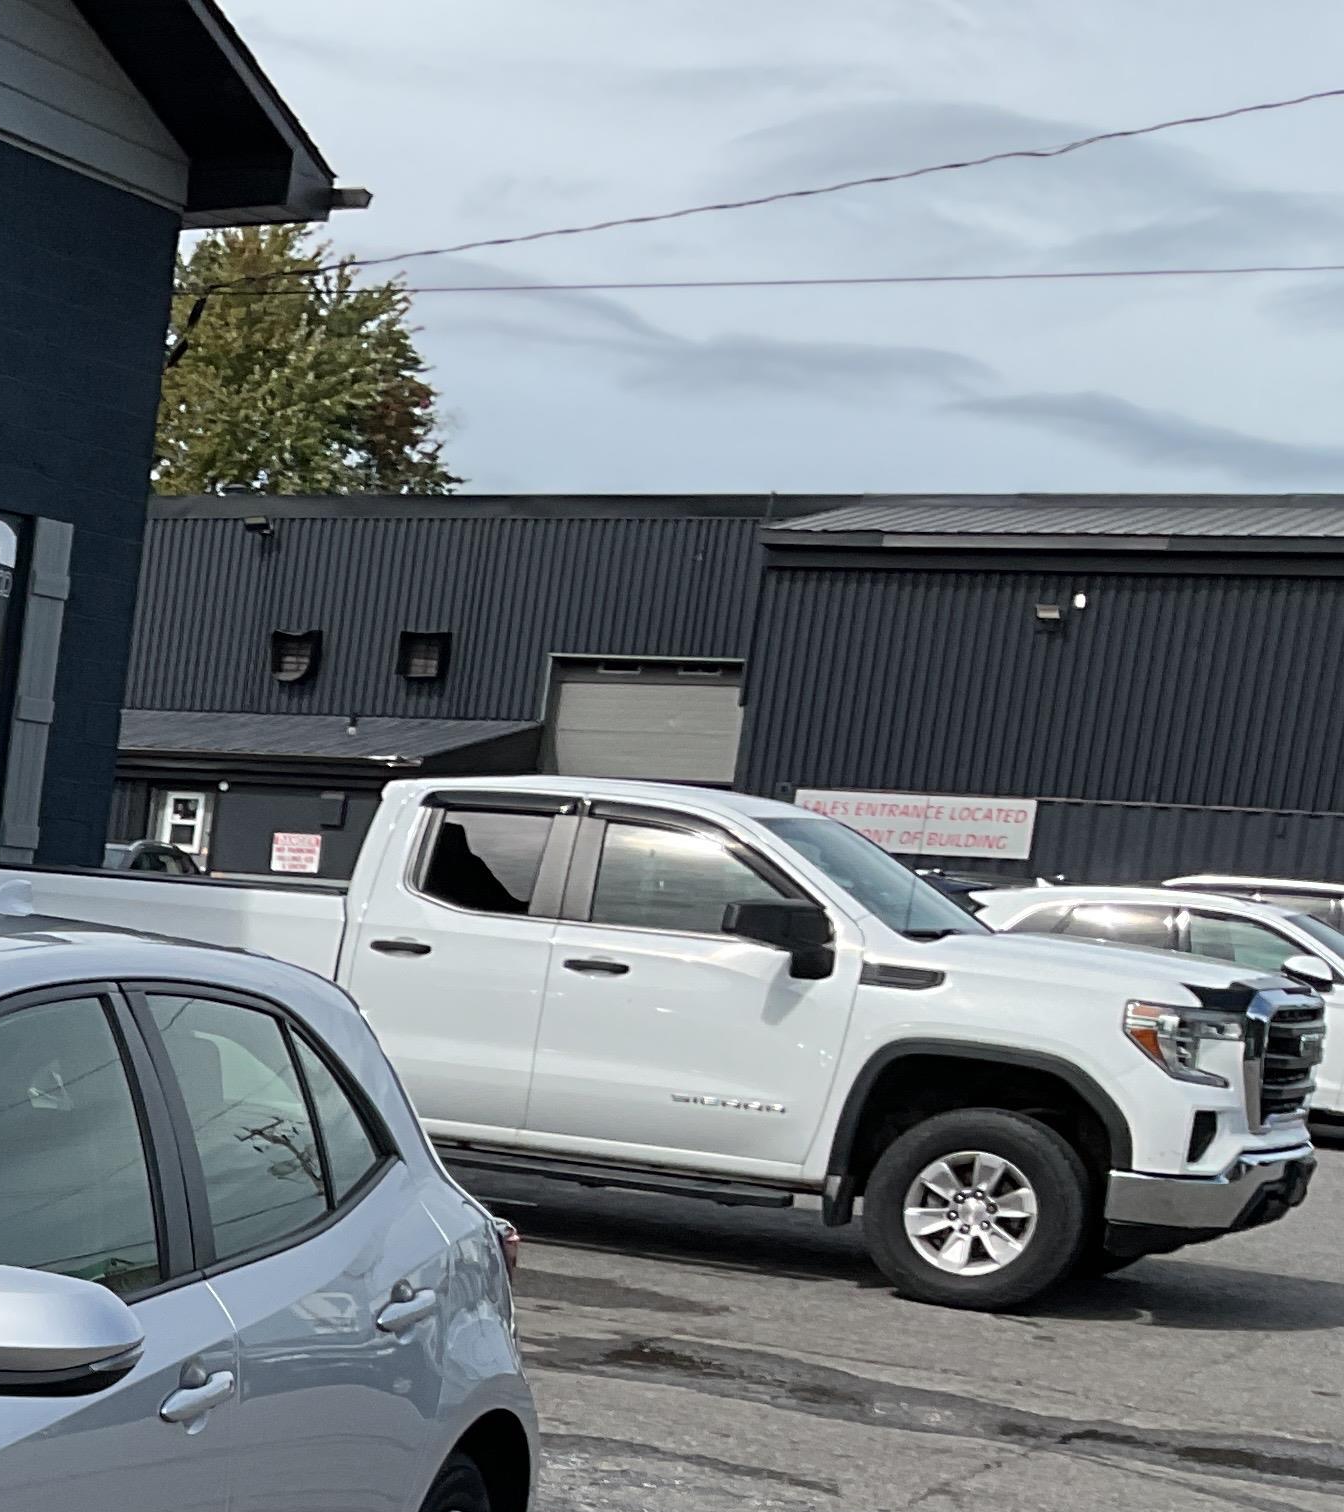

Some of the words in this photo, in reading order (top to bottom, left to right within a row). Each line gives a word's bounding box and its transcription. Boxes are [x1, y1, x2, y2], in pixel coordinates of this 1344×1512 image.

[854, 802, 945, 821] ENTRANCE
[949, 805, 1028, 824] LOCATED
[855, 828, 895, 845] ONT
[898, 829, 923, 845] OF
[926, 832, 1008, 850] BUILDING
